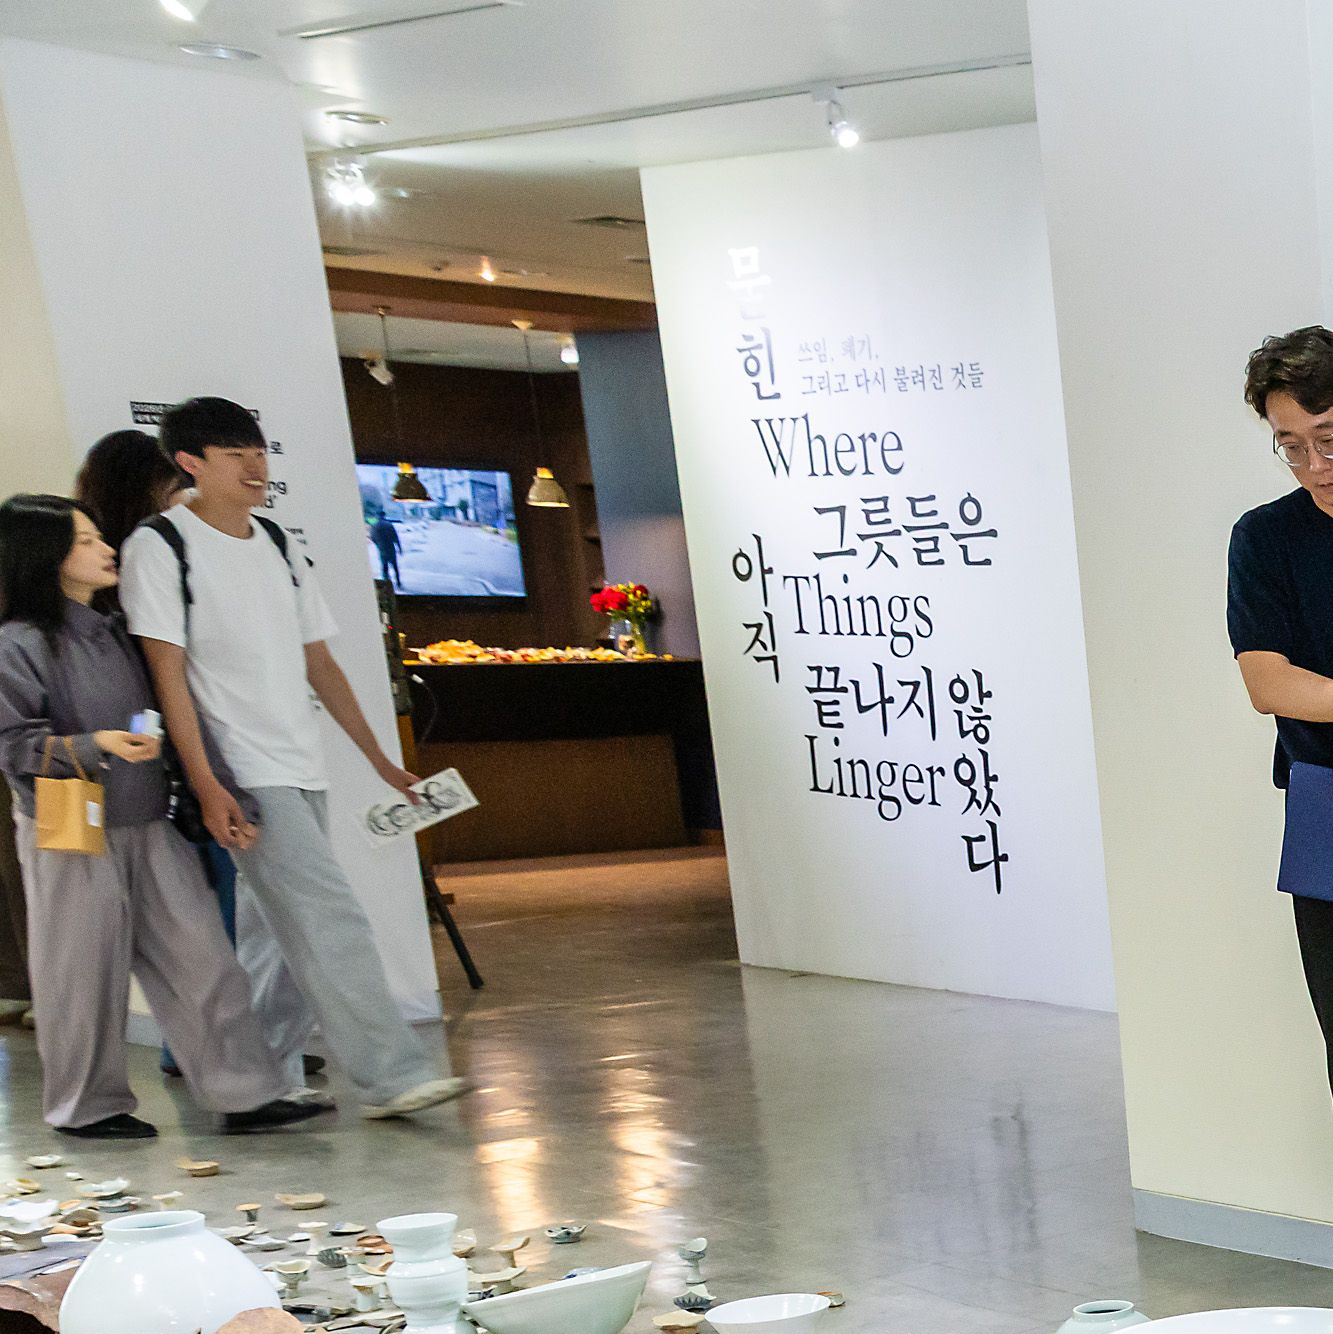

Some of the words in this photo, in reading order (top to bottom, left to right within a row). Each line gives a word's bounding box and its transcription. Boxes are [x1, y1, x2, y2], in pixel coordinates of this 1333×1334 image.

[801, 370, 849, 397] 그리고
[855, 368, 887, 394] 다시
[894, 363, 945, 393] 불려진
[951, 361, 984, 390] 것들
[752, 414, 905, 480] Where
[813, 492, 999, 570] 그릇들은
[731, 534, 782, 684] 아직
[782, 574, 934, 658] Things
[805, 662, 939, 742] 끝나지
[805, 733, 947, 822] Linger
